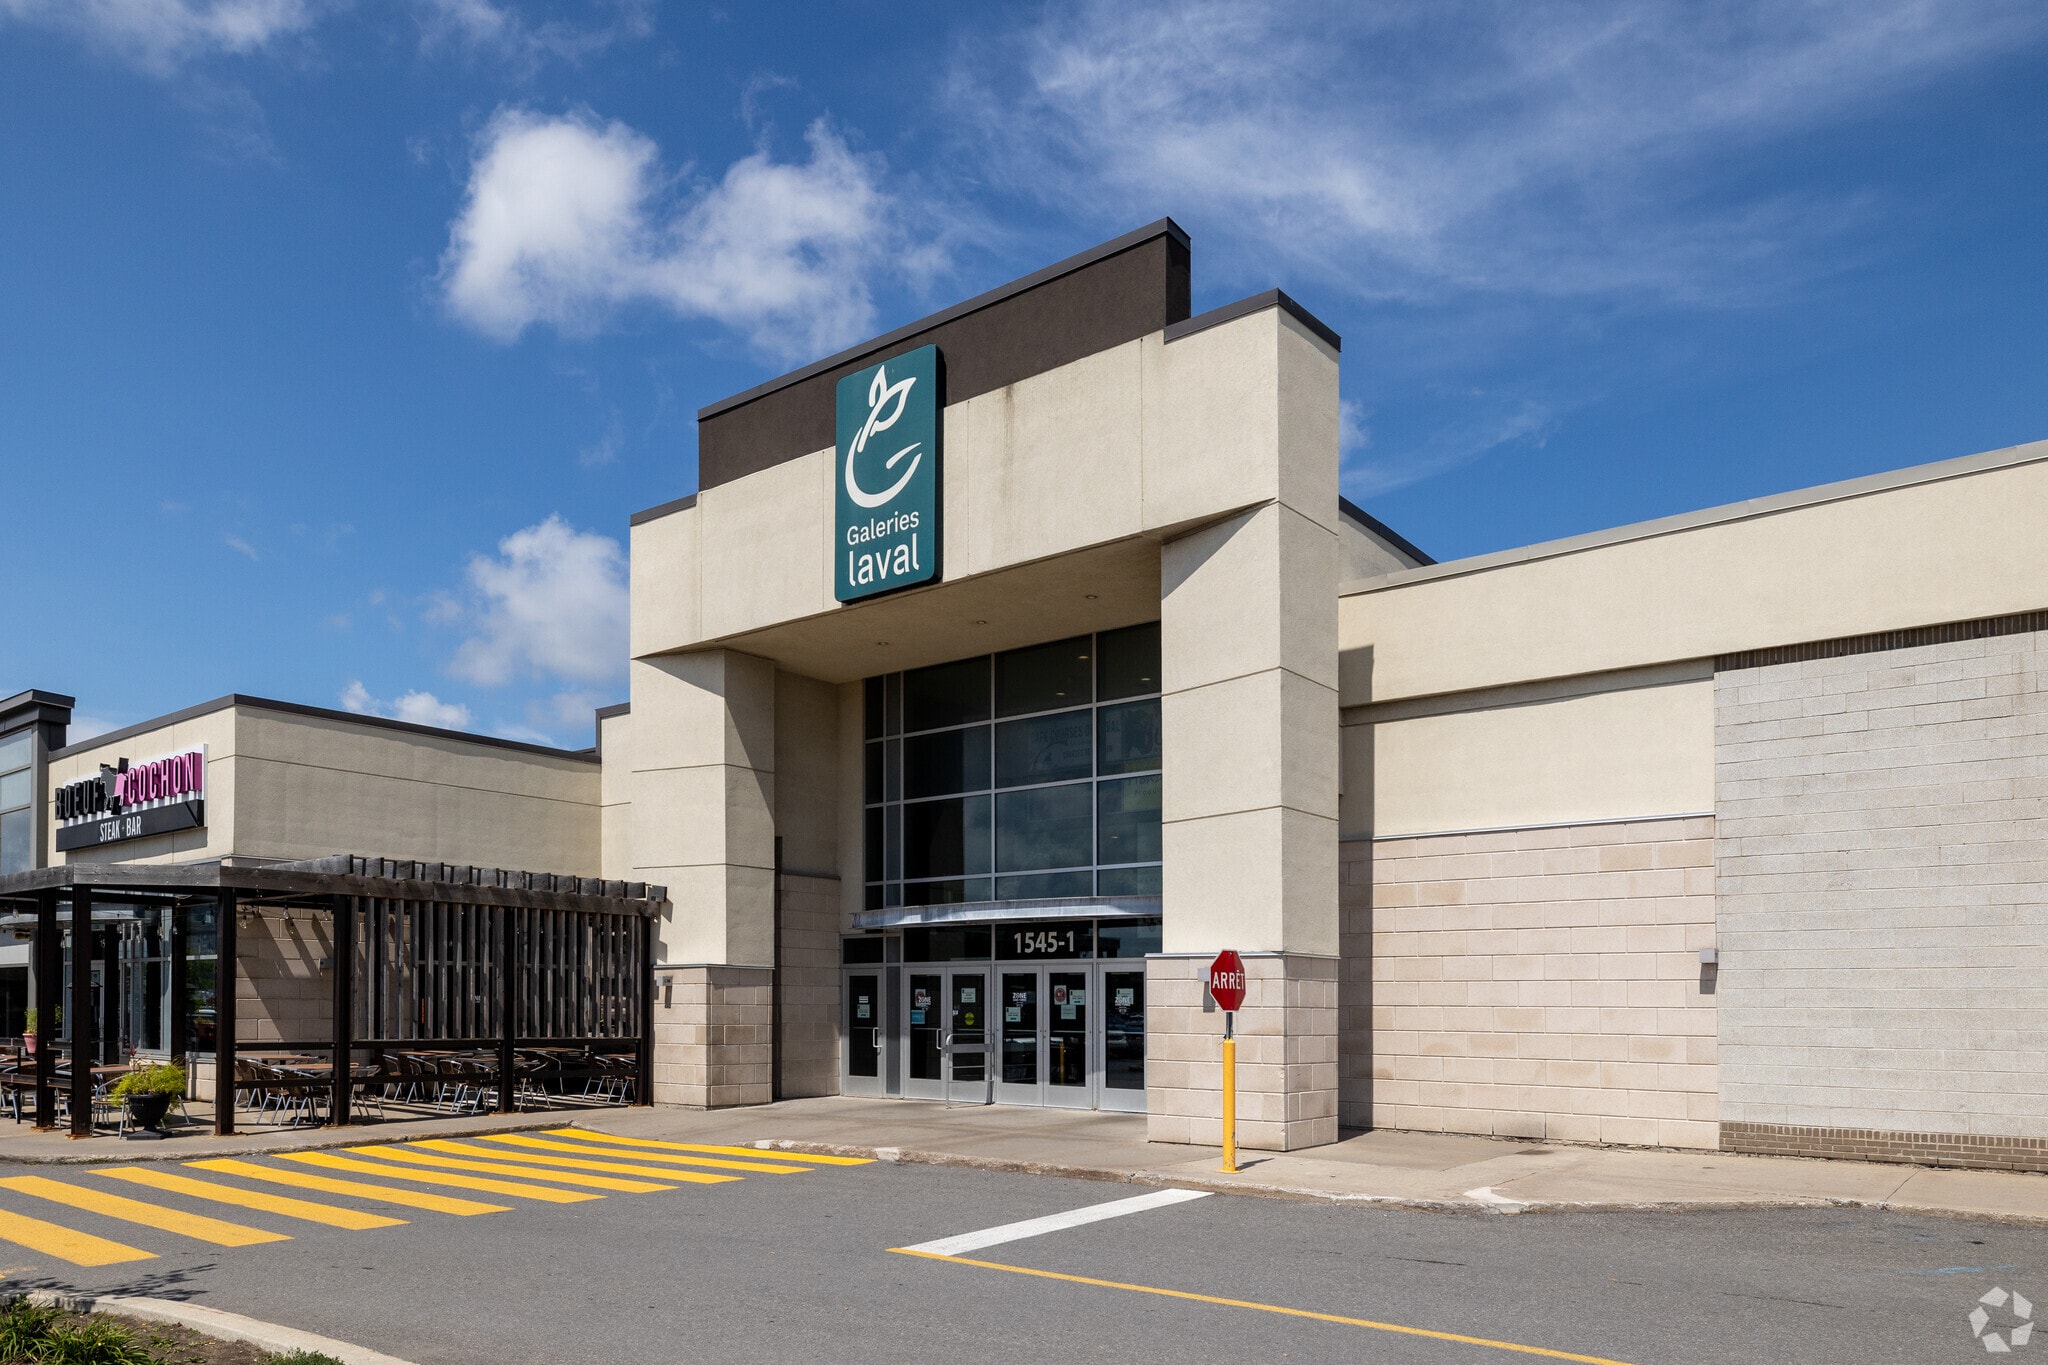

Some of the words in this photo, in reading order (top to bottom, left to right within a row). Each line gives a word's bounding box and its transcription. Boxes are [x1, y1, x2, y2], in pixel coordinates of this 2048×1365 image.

[847, 511, 919, 545] Galeries
[849, 533, 920, 586] laval
[55, 777, 104, 820] BOEUF
[127, 752, 197, 804] COCHON
[100, 820, 120, 842] STEAK
[126, 815, 142, 837] BAR
[1014, 931, 1074, 953] 1545-1
[1212, 969, 1244, 990] ARRÊT
